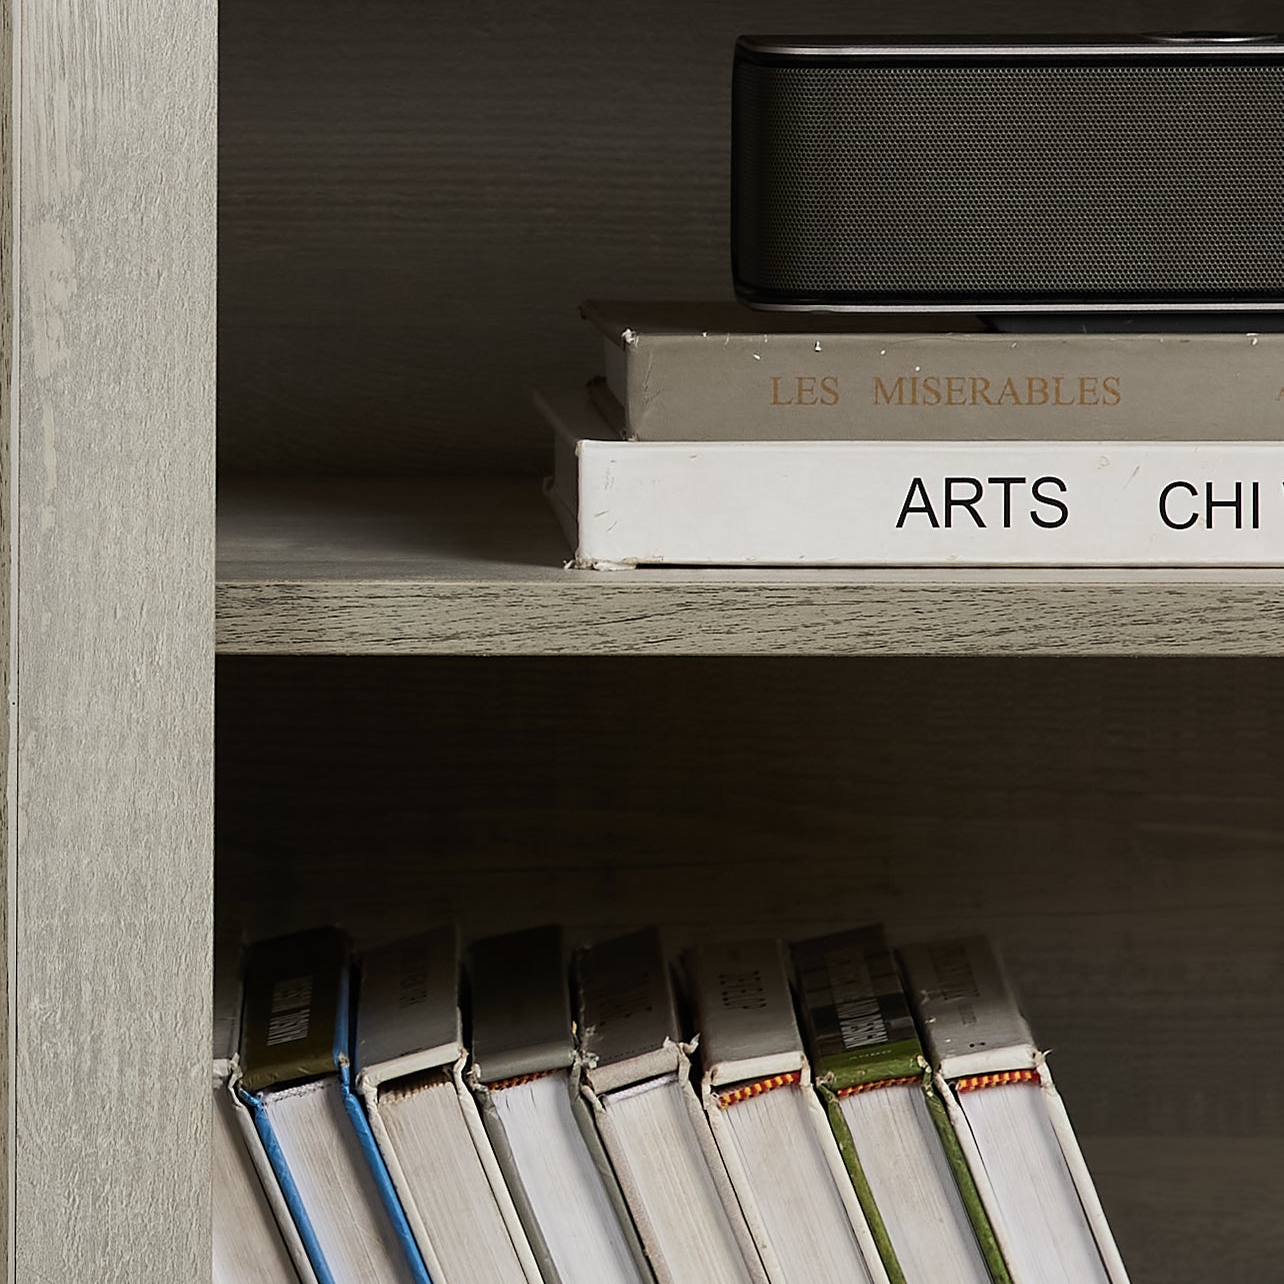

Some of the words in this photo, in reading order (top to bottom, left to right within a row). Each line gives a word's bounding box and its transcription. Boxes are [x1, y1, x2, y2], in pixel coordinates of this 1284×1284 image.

[769, 375, 840, 407] LES
[872, 375, 1122, 407] MISERABLES
[895, 476, 1070, 529] ARTS
[1159, 480, 1261, 530] CHI
